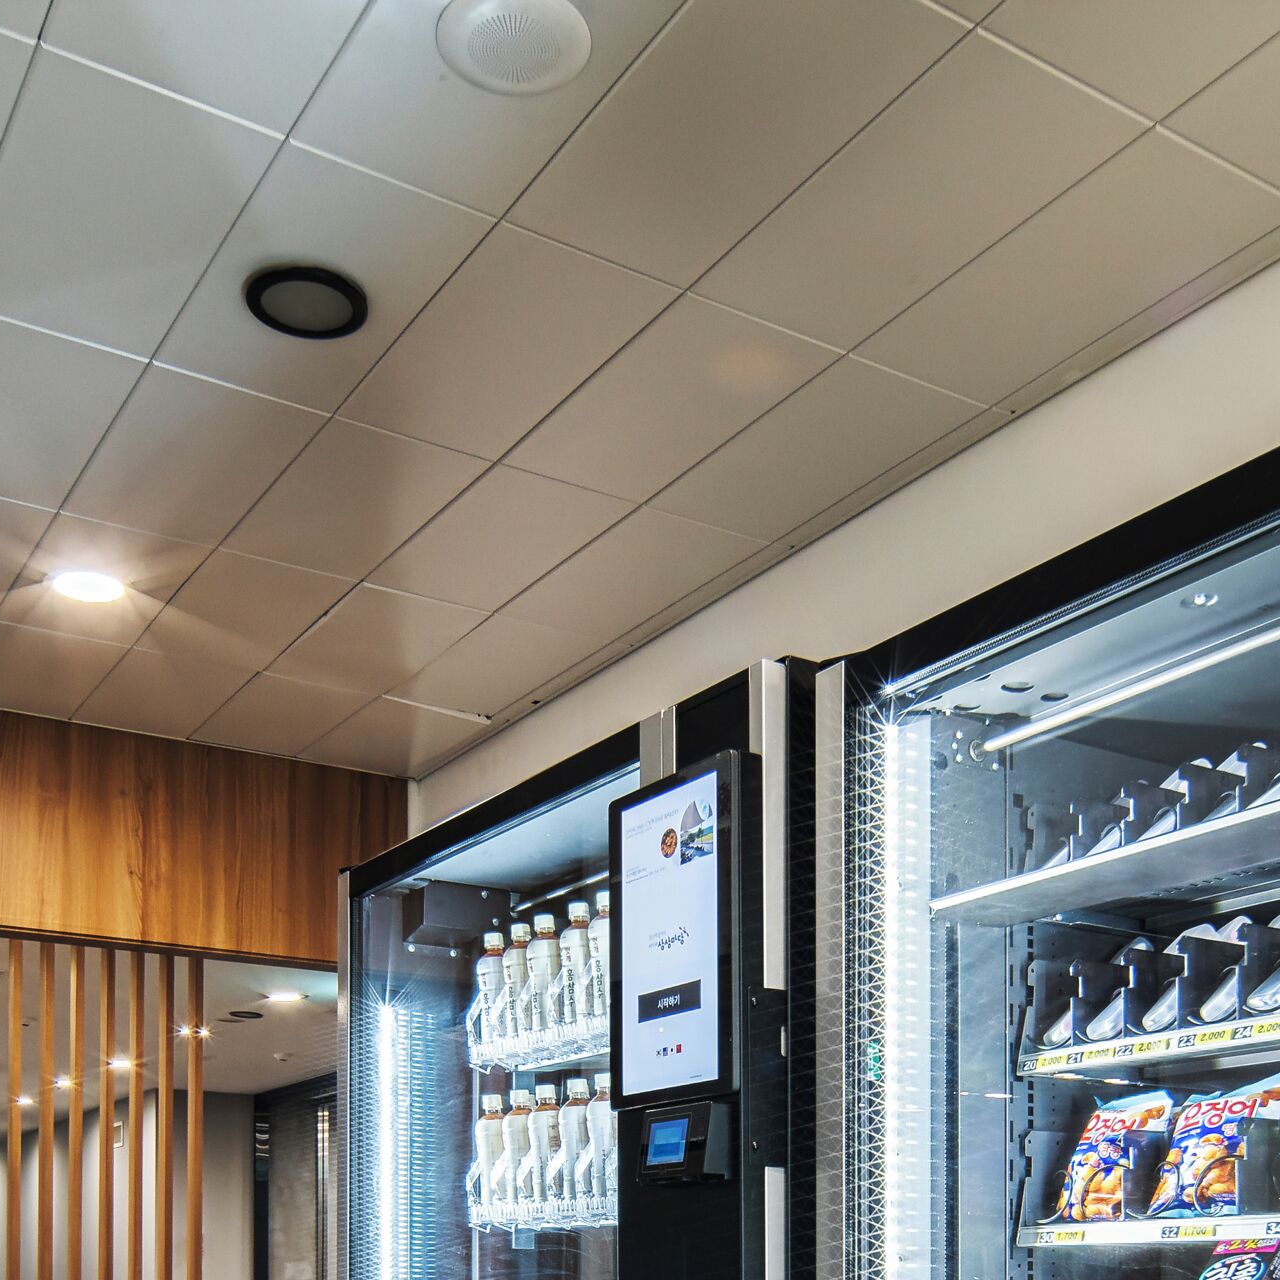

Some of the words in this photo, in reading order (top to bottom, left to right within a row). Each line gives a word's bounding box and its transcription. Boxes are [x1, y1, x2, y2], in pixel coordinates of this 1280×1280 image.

[1235, 1027, 1251, 1039] 24
[1179, 1036, 1194, 1047] 23
[1117, 1045, 1132, 1055] 22
[1068, 1053, 1082, 1064] 21
[1024, 1061, 1035, 1070] 20
[1177, 1098, 1258, 1132] 오징어
[1162, 1227, 1177, 1237] 32
[1040, 1233, 1053, 1242] 30
